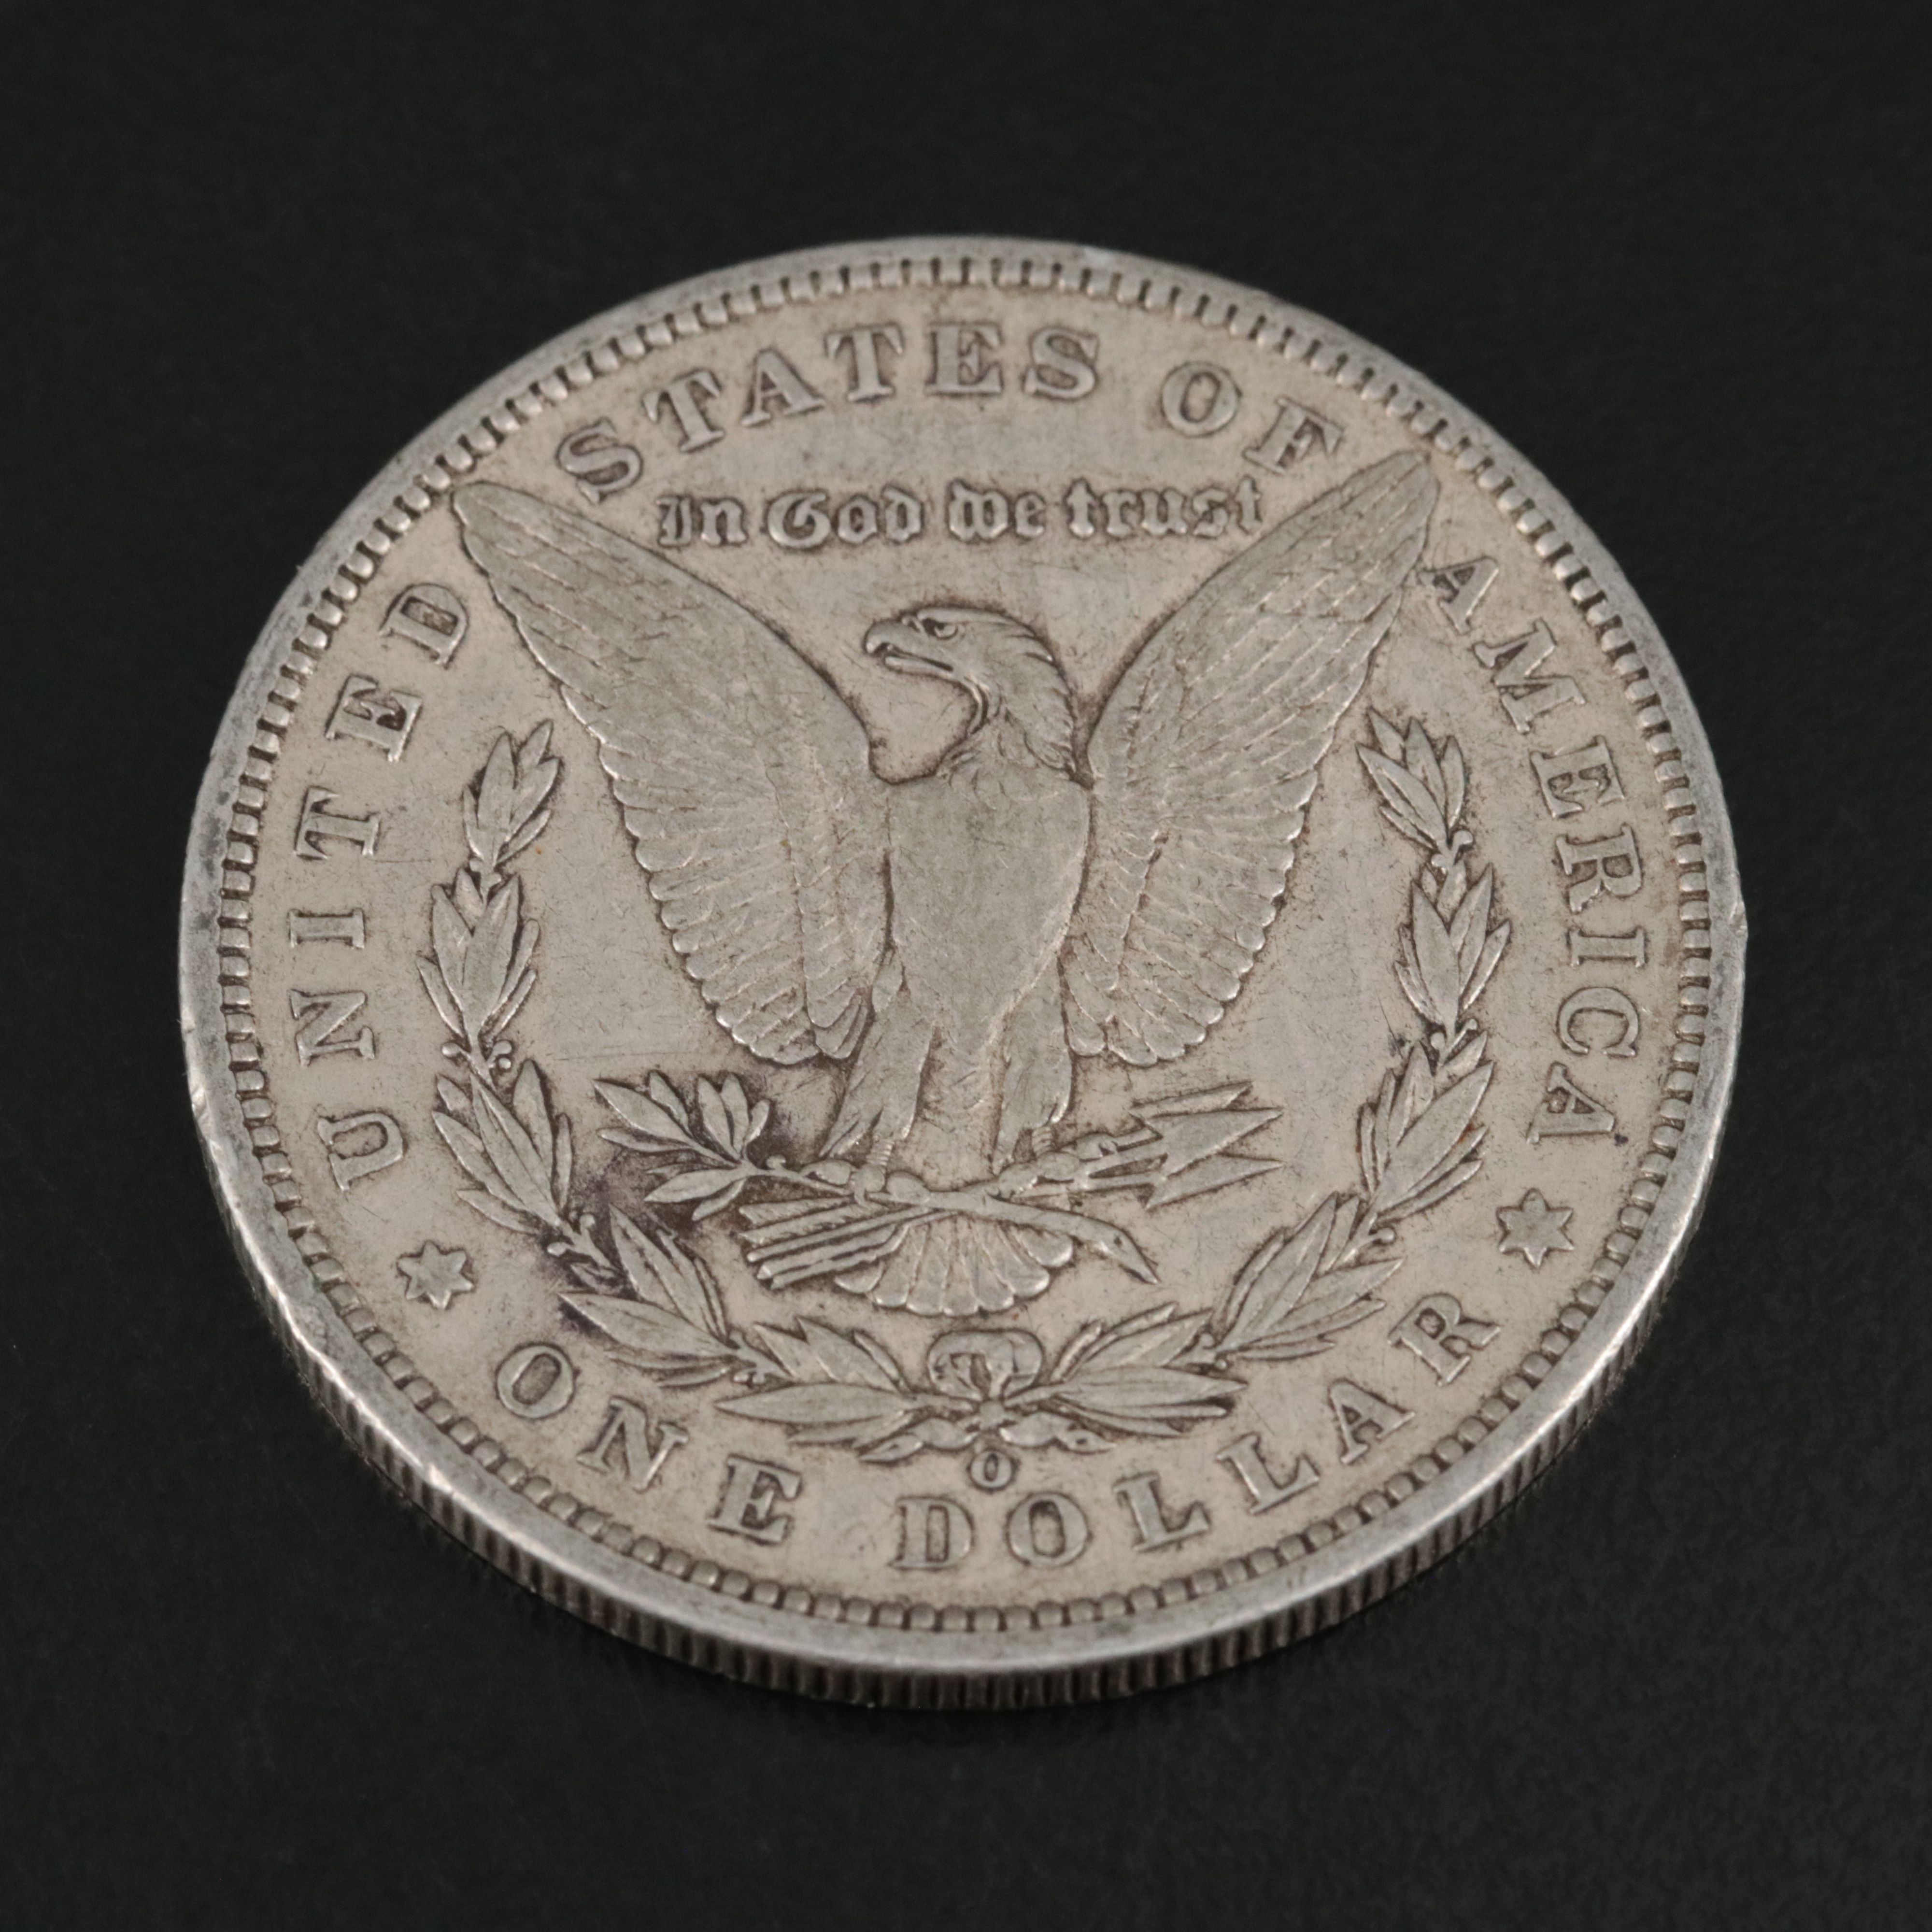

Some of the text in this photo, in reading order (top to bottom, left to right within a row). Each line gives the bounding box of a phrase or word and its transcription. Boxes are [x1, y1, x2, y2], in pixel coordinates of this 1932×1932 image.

[657, 478, 1265, 552] In God we trust
[288, 320, 1646, 1191] UNITED STATES OF AMERICA
[494, 1291, 1502, 1572] ONE DOLLAR
